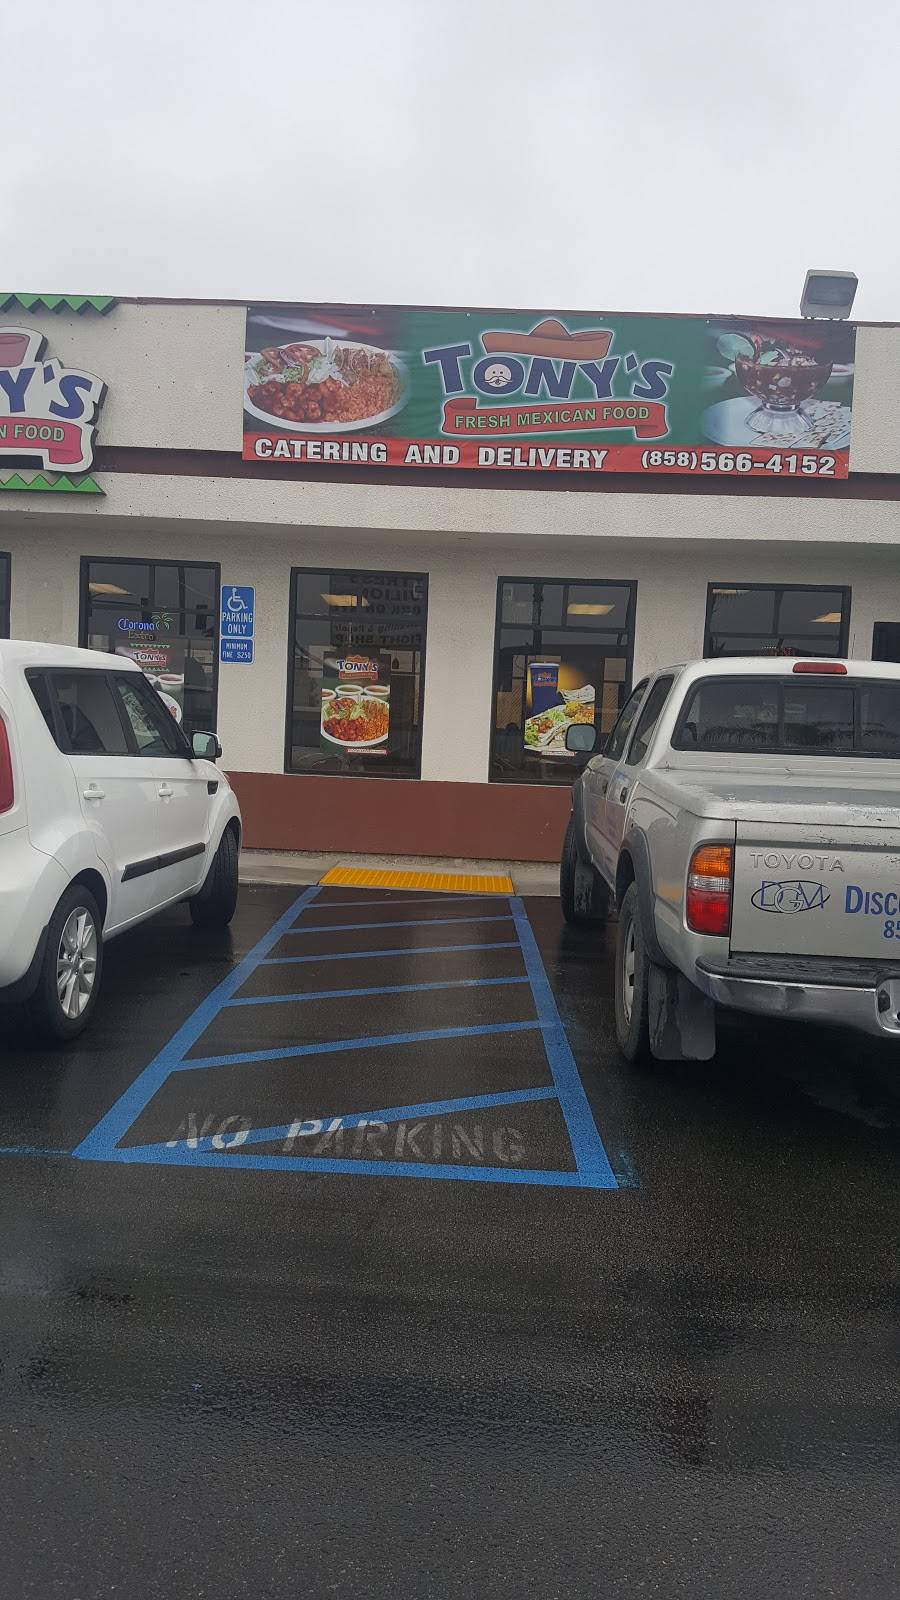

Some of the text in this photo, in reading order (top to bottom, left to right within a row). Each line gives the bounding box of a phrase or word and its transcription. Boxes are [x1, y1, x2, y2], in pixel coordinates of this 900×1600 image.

[423, 343, 673, 399] TONY'S
[0, 365, 93, 420] Y'S
[455, 406, 650, 428] FRESH MEXICAN FOOD
[14, 423, 65, 442] FOOD
[254, 438, 388, 463] CATERING
[404, 443, 460, 466] AND
[478, 446, 608, 469] DELIVERY
[117, 618, 155, 631] Corona
[222, 612, 253, 623] PARKING
[227, 624, 247, 634] ONLY
[225, 642, 248, 650] MINIMUM
[336, 660, 378, 672] TONY'S
[750, 852, 845, 872] TOYOTA
[844, 885, 900, 916] DISC
[165, 1111, 528, 1163] NO PARKING
